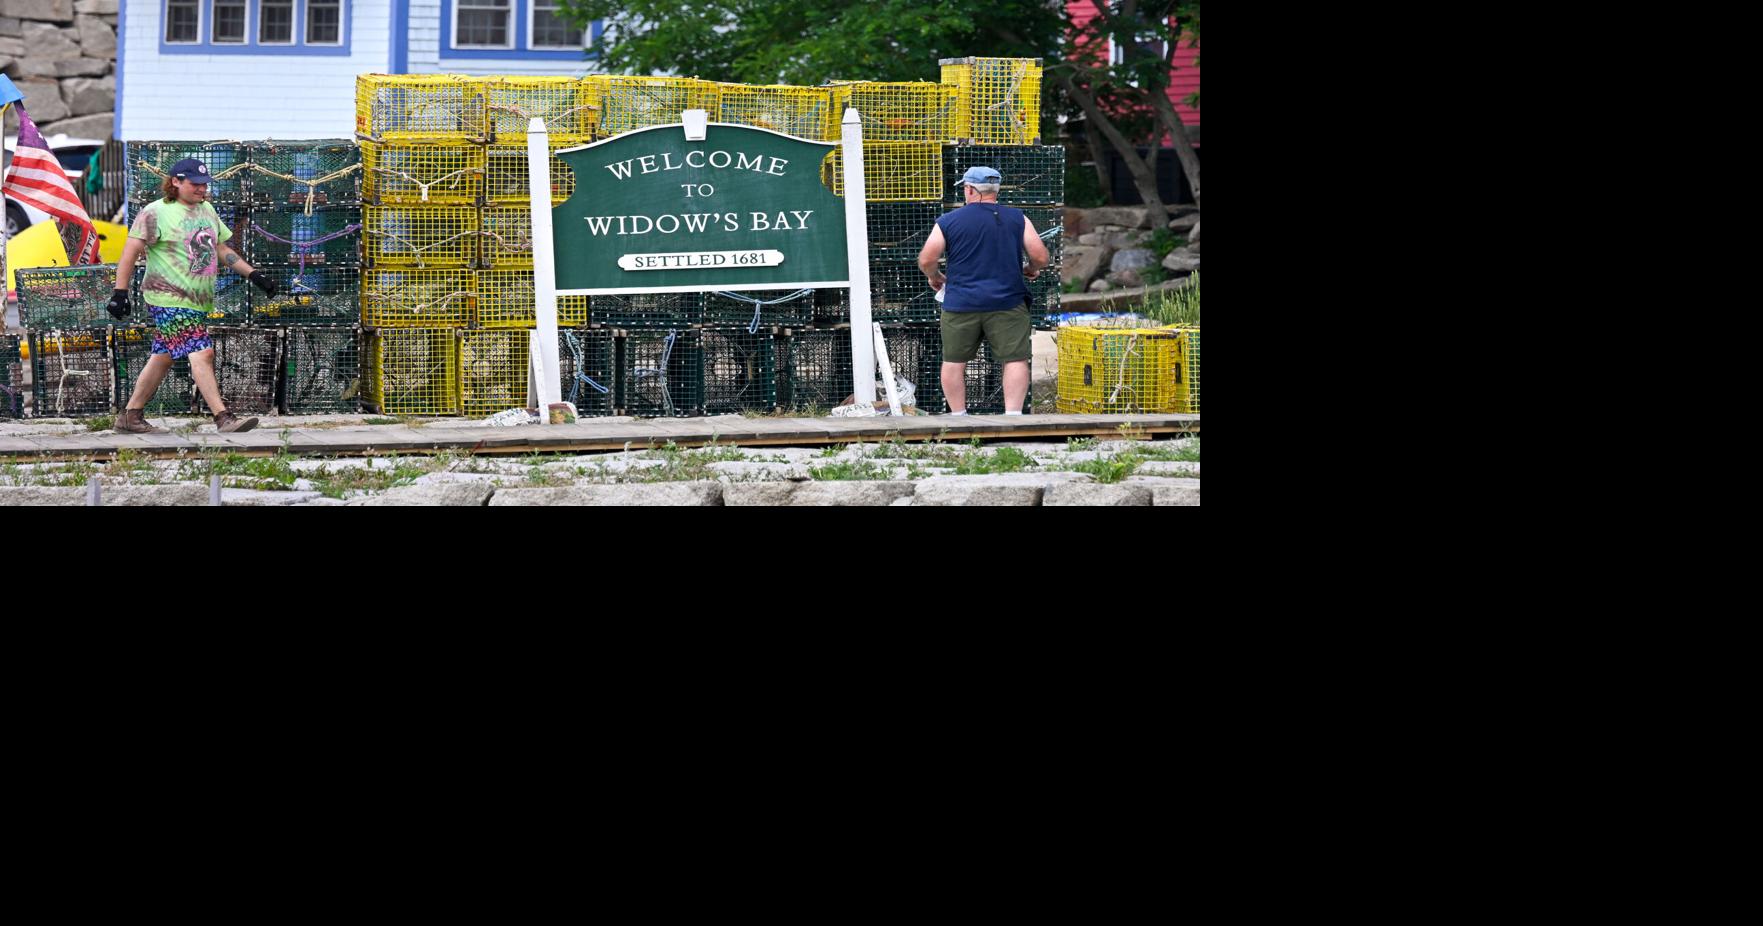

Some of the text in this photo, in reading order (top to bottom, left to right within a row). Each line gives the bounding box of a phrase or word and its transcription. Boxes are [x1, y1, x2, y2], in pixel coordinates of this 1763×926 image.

[604, 150, 789, 180] WELCOME
[681, 183, 714, 198] TO
[584, 211, 814, 236] WIDOW'S BAY
[634, 253, 767, 268] SETTLED 1681
